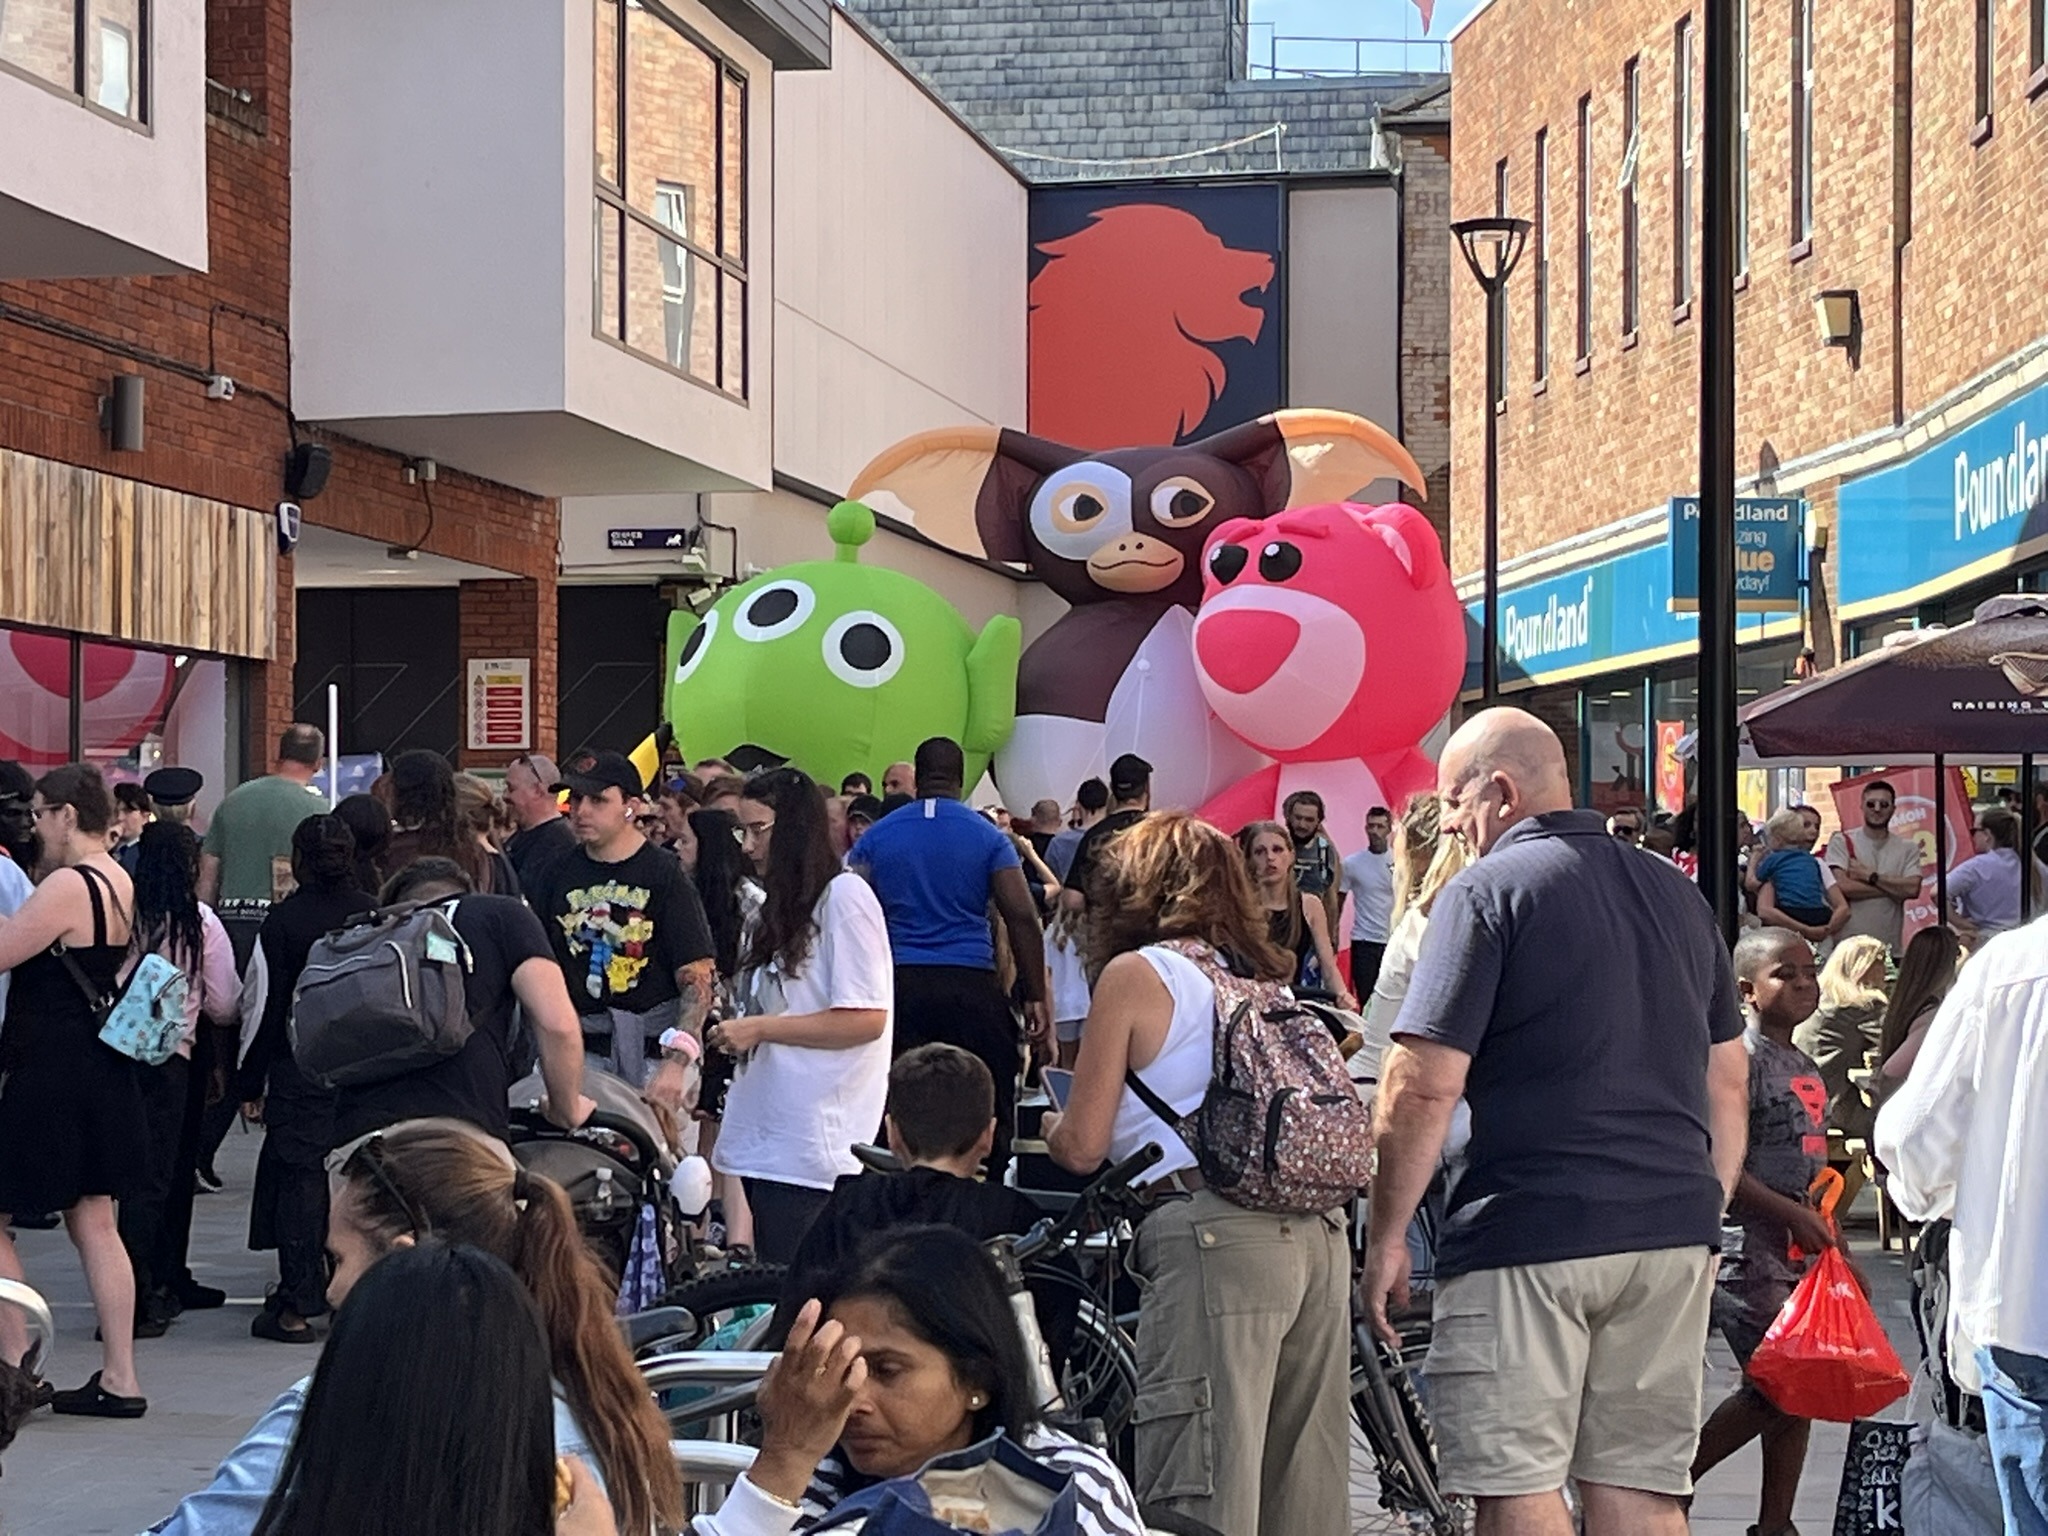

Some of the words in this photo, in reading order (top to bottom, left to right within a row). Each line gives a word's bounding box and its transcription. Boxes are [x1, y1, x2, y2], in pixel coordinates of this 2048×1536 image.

[1683, 503, 1789, 522] Pdland
[1736, 527, 1768, 548] zing
[1735, 545, 1776, 572] lue
[1505, 580, 1589, 662] Poundland
